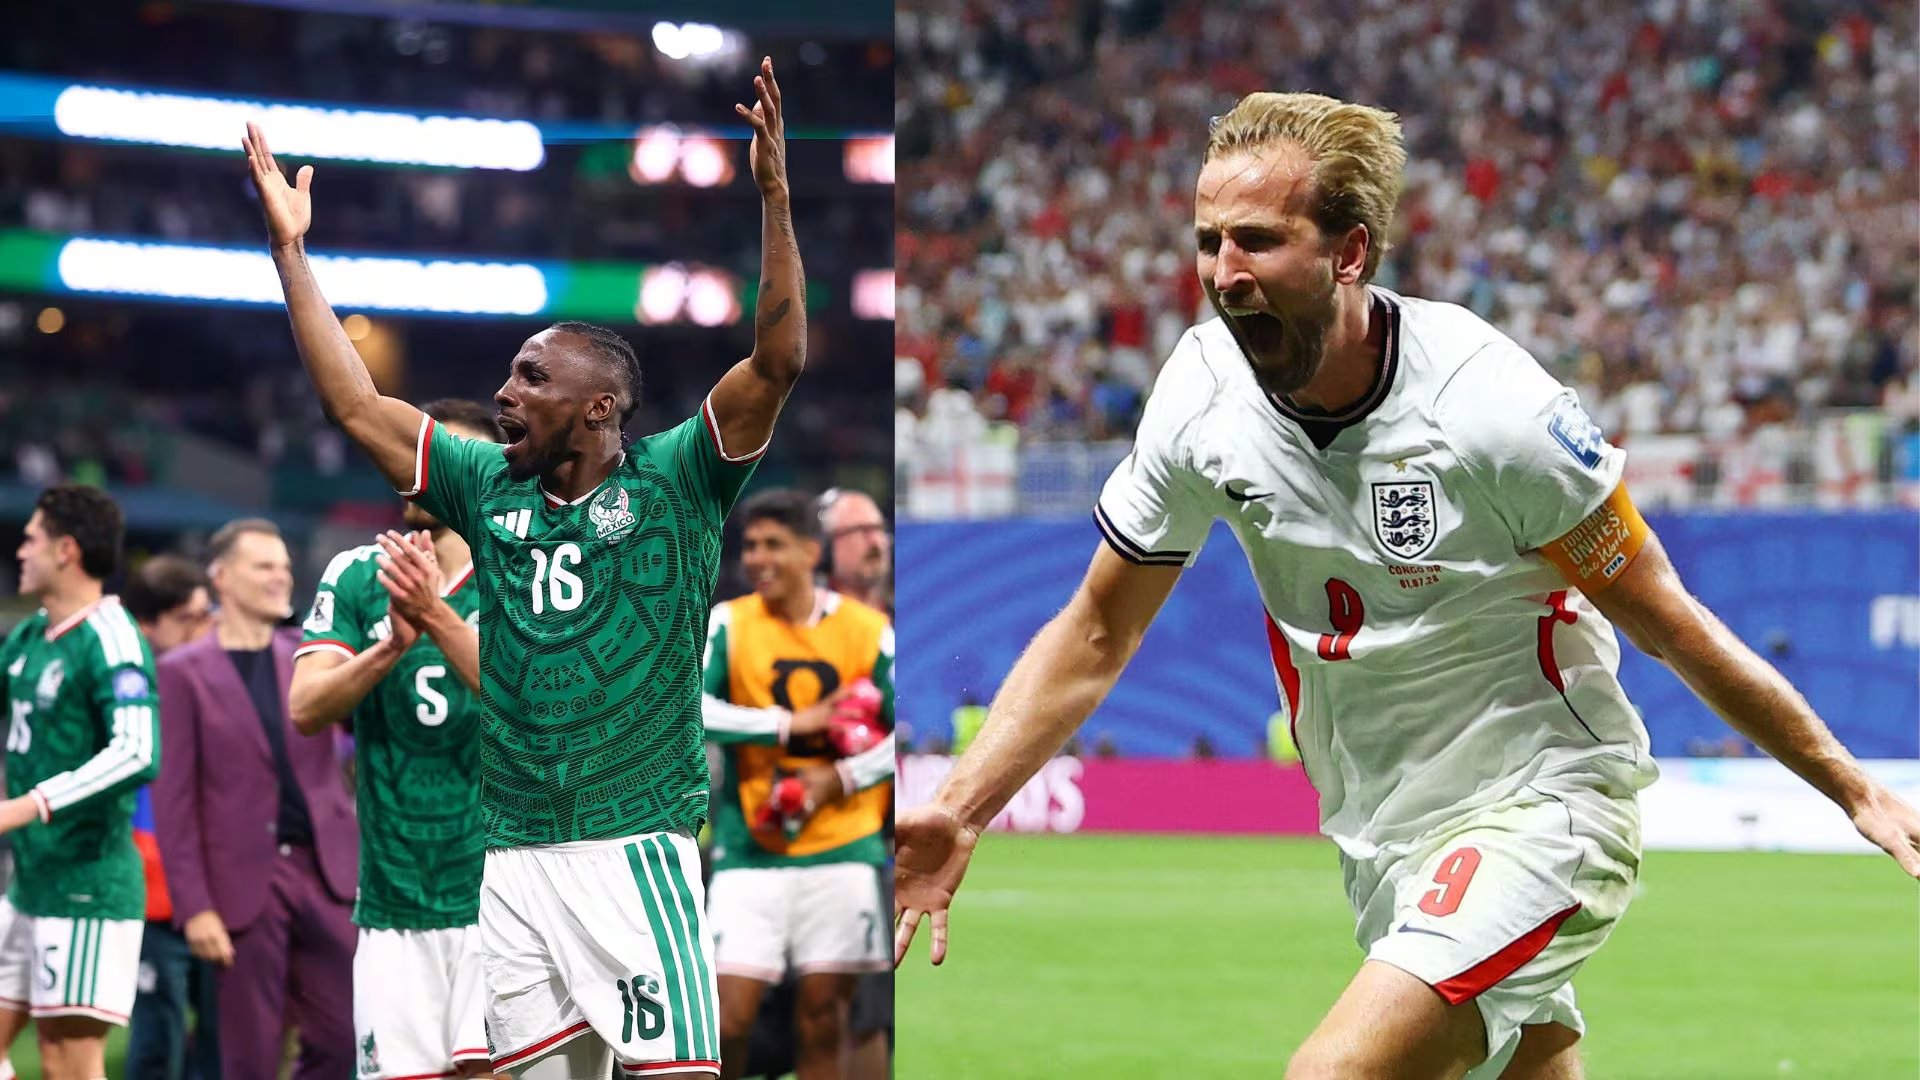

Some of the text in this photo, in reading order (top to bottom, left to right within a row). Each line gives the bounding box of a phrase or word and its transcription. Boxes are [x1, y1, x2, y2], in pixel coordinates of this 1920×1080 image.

[1568, 510, 1620, 565] UNITES
[1597, 522, 1631, 563] World
[1604, 555, 1624, 575] FIFA
[530, 543, 583, 614] 16
[1388, 565, 1424, 575] CONGO
[1317, 577, 1364, 661] 9
[415, 665, 448, 726] 5
[1417, 846, 1482, 917] 9
[616, 974, 666, 1044] 16
